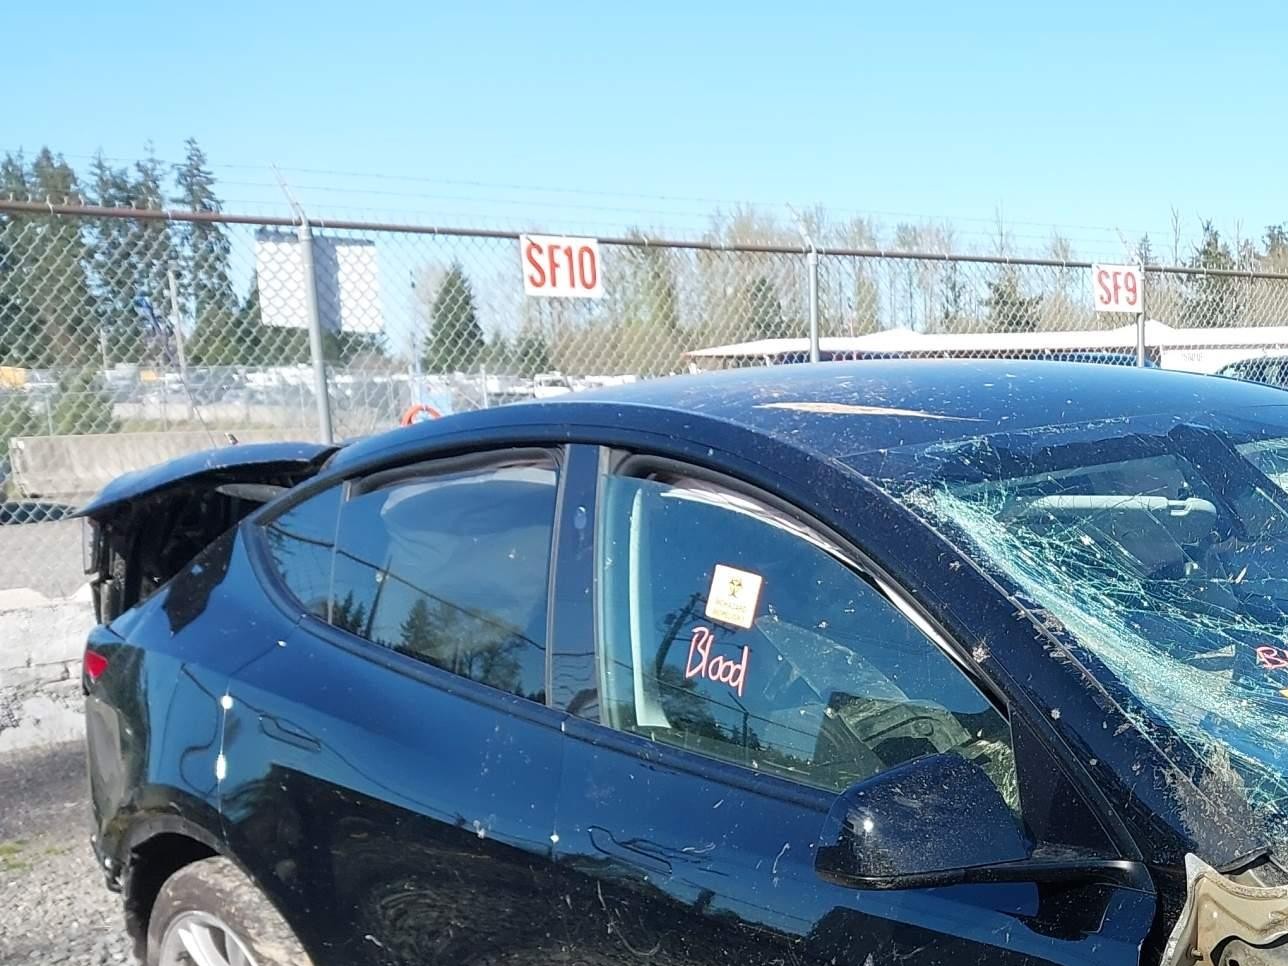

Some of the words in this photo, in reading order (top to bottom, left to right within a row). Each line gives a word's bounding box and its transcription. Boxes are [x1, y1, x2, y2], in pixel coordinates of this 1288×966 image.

[526, 243, 597, 290] SF10
[1097, 270, 1137, 306] SF9
[685, 626, 749, 698] Blood
